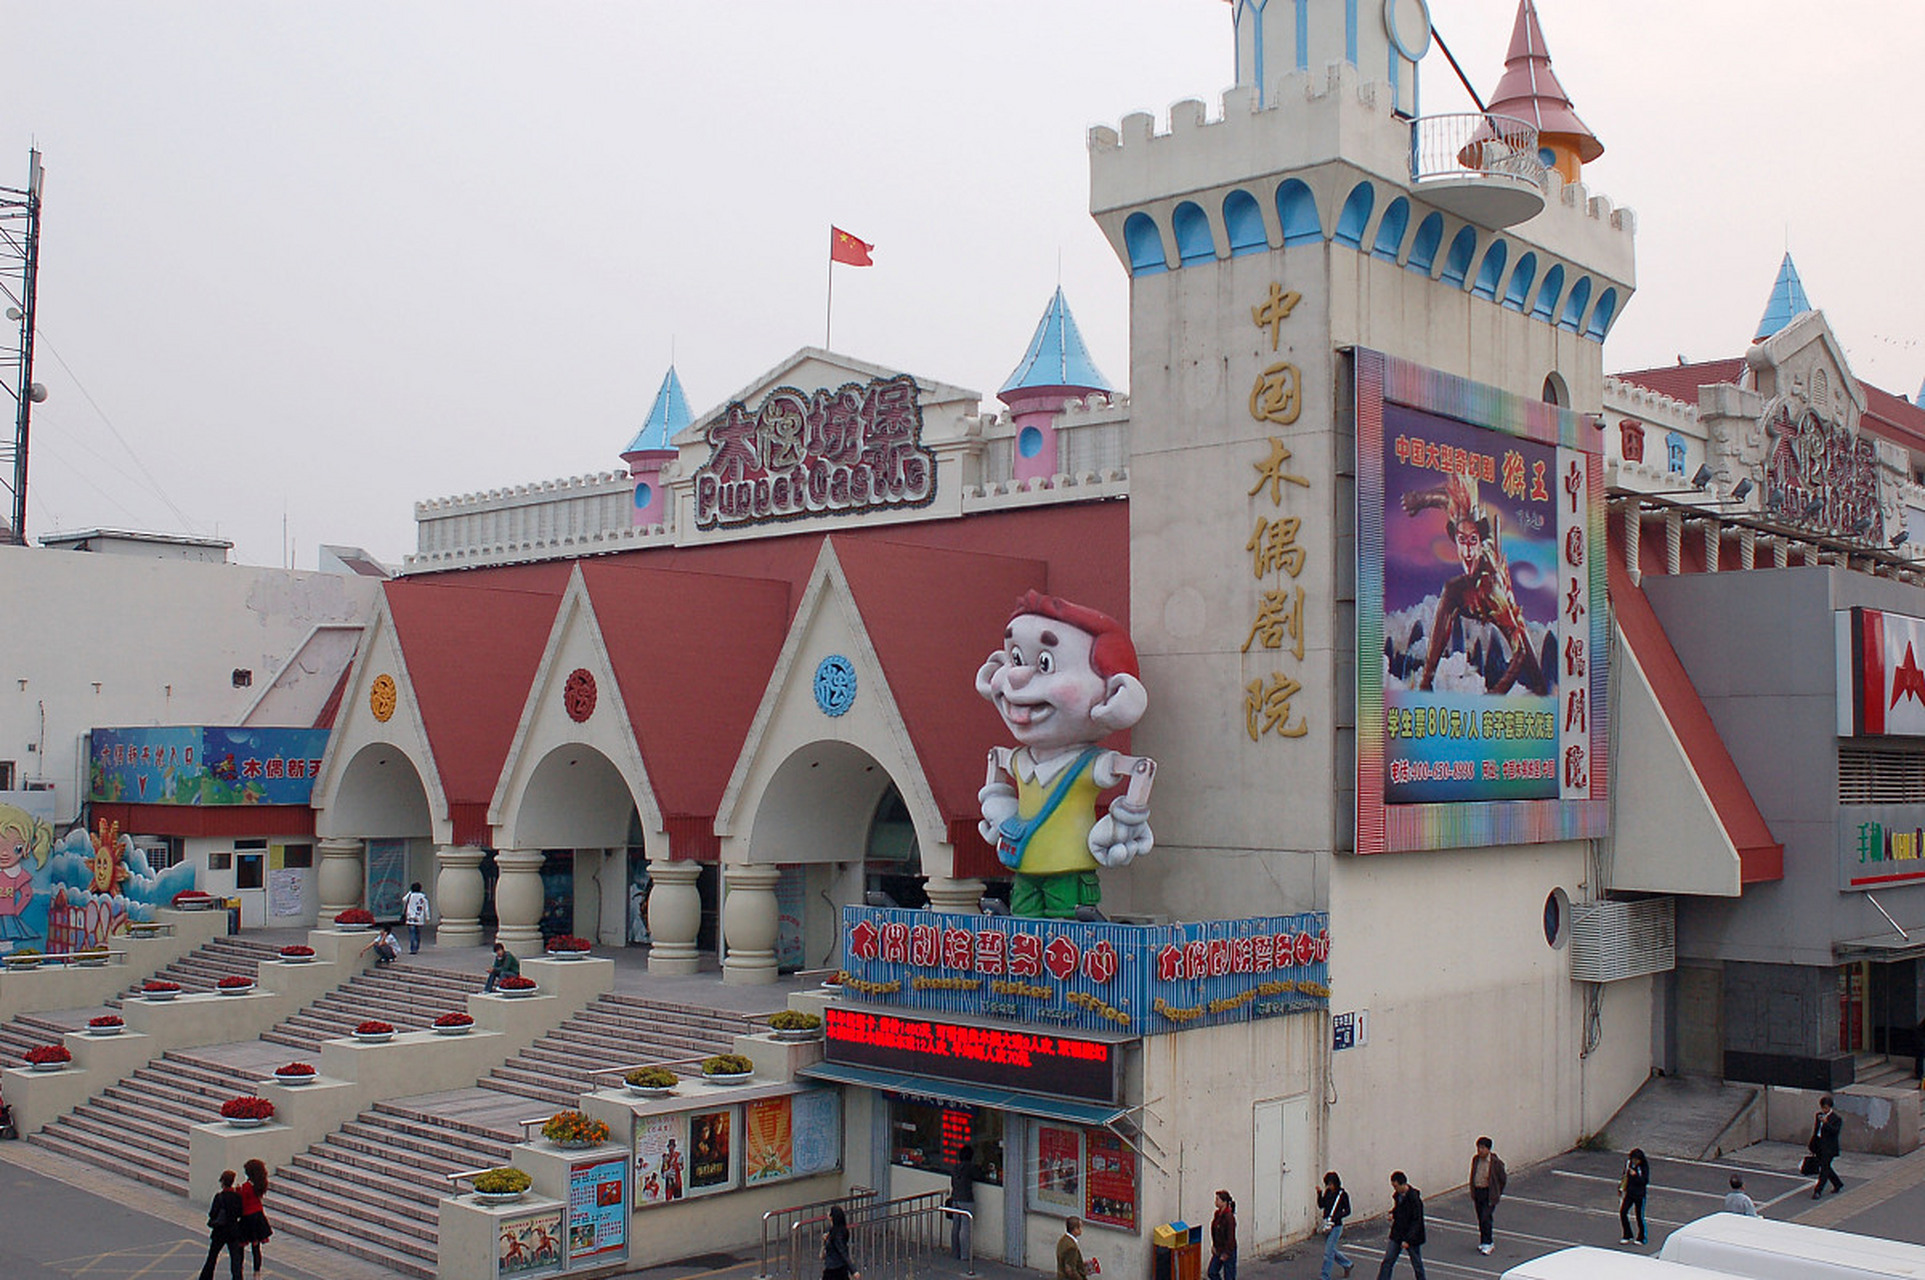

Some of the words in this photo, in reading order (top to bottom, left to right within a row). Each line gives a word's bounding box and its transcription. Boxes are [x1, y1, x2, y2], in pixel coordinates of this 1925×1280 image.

[699, 465, 806, 520] Puppet
[808, 447, 926, 504] Castle
[1395, 434, 1496, 483] 中国大型奇幻剧
[1502, 450, 1549, 502] 猴王
[1242, 281, 1310, 742] 中国木偶剧院
[1387, 706, 1479, 740] 学生票80元/人
[912, 975, 982, 992] theater
